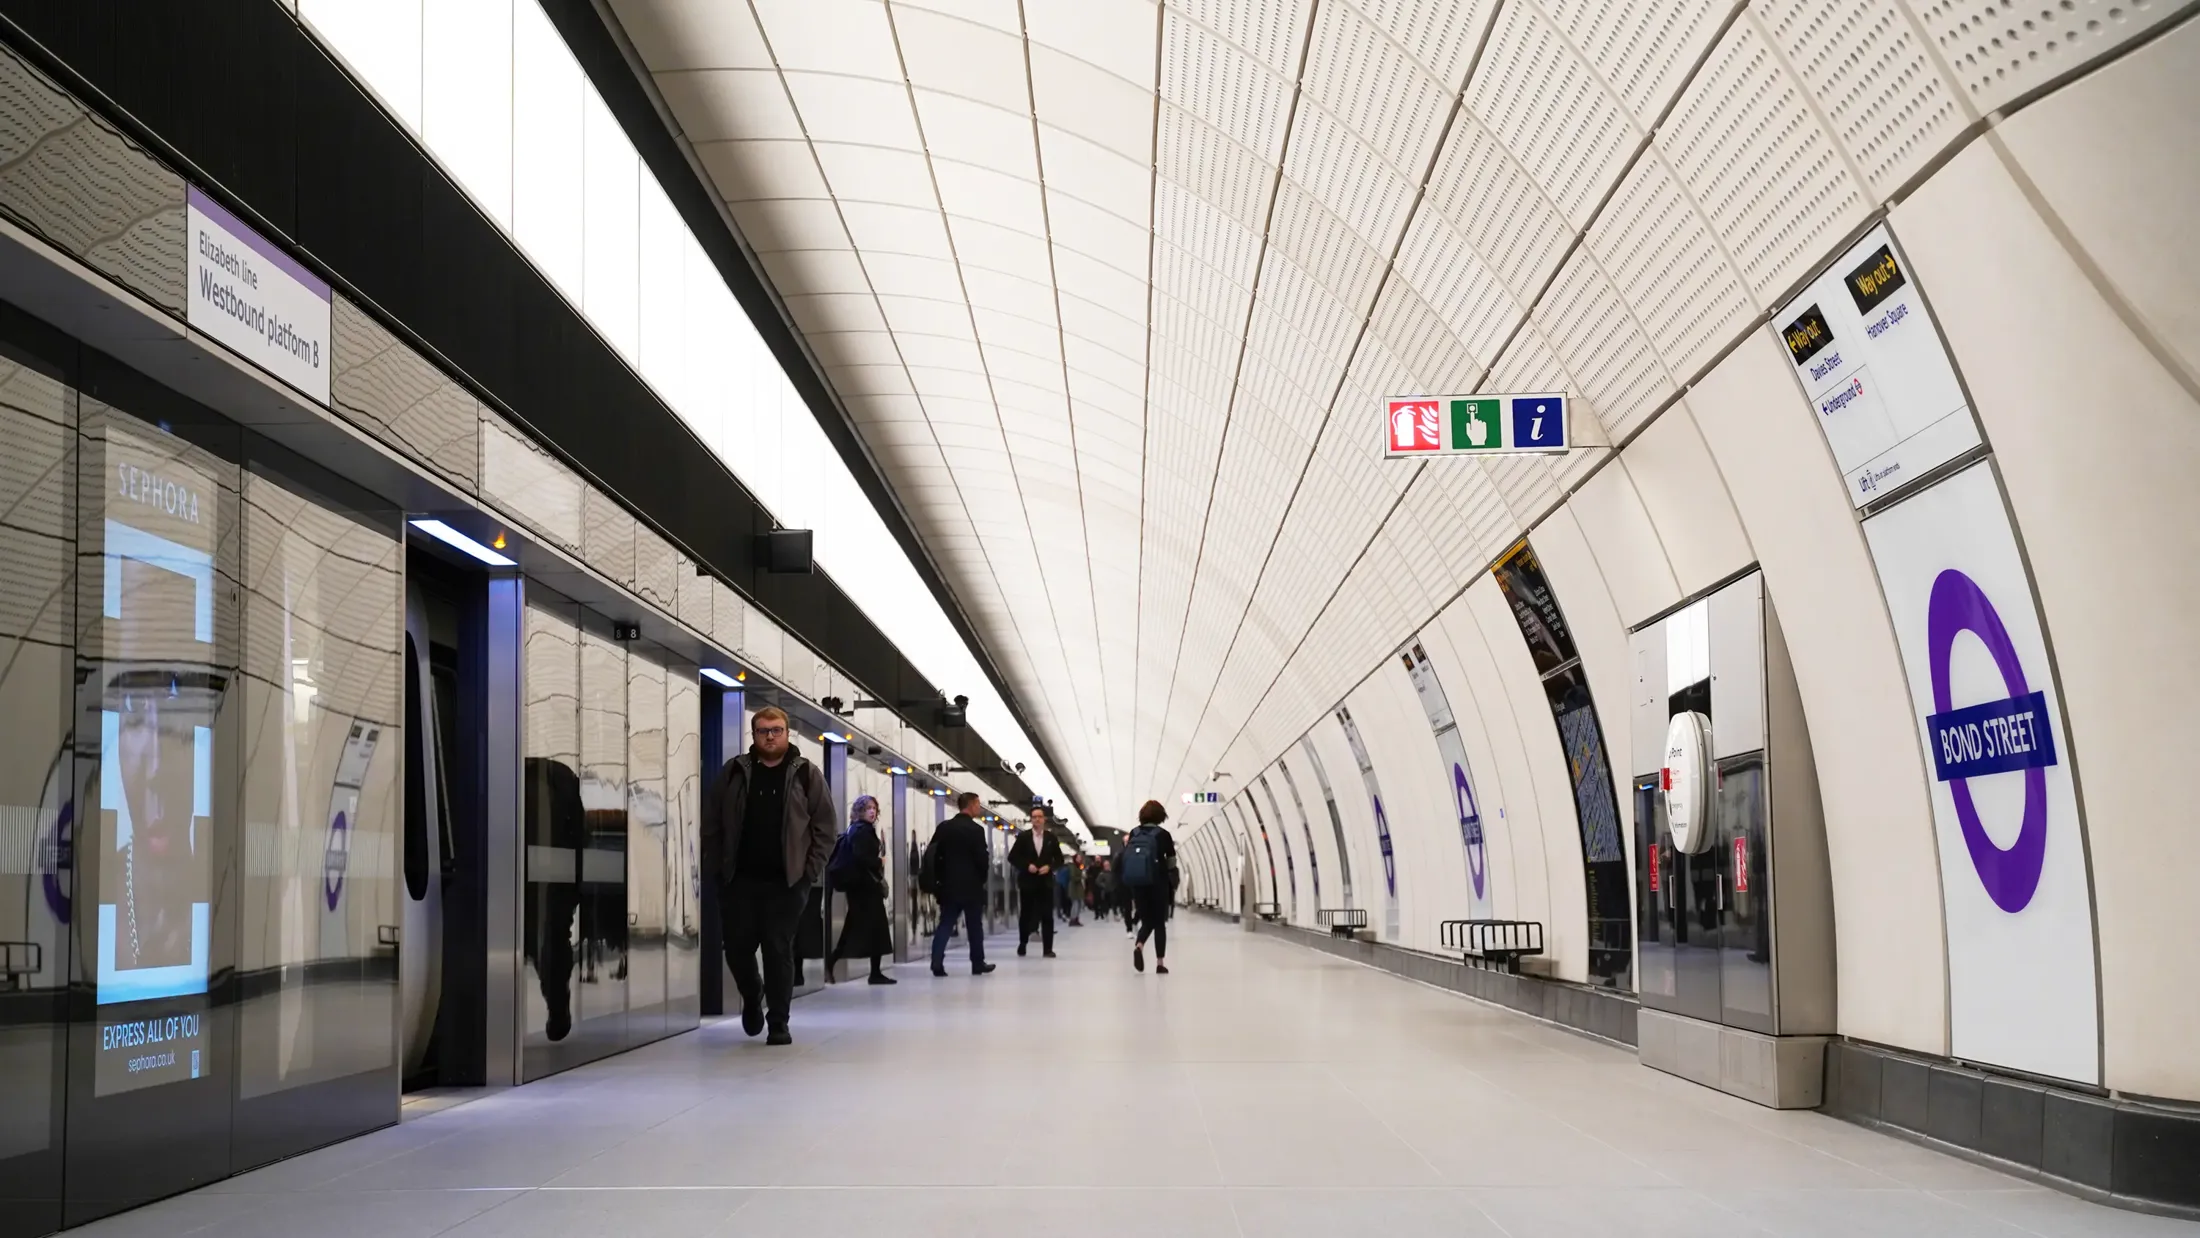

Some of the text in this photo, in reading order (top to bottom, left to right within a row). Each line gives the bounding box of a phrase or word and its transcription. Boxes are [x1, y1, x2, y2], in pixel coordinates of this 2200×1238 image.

[200, 230, 258, 290] Elizabeth line
[1856, 261, 1890, 296] Way out
[199, 265, 319, 369] Westbound platform B
[1791, 318, 1822, 349] Way out
[1864, 303, 1909, 341] Hanover Square
[1809, 349, 1843, 382] Davies Street
[1825, 383, 1857, 413] Underground
[118, 462, 199, 524] SEPHORA
[630, 628, 637, 639] 8
[1940, 711, 2037, 764] BOND STREET
[103, 1014, 200, 1051] EXPRESS ALL OF YOU
[128, 1050, 176, 1074] sephora.co.uk
